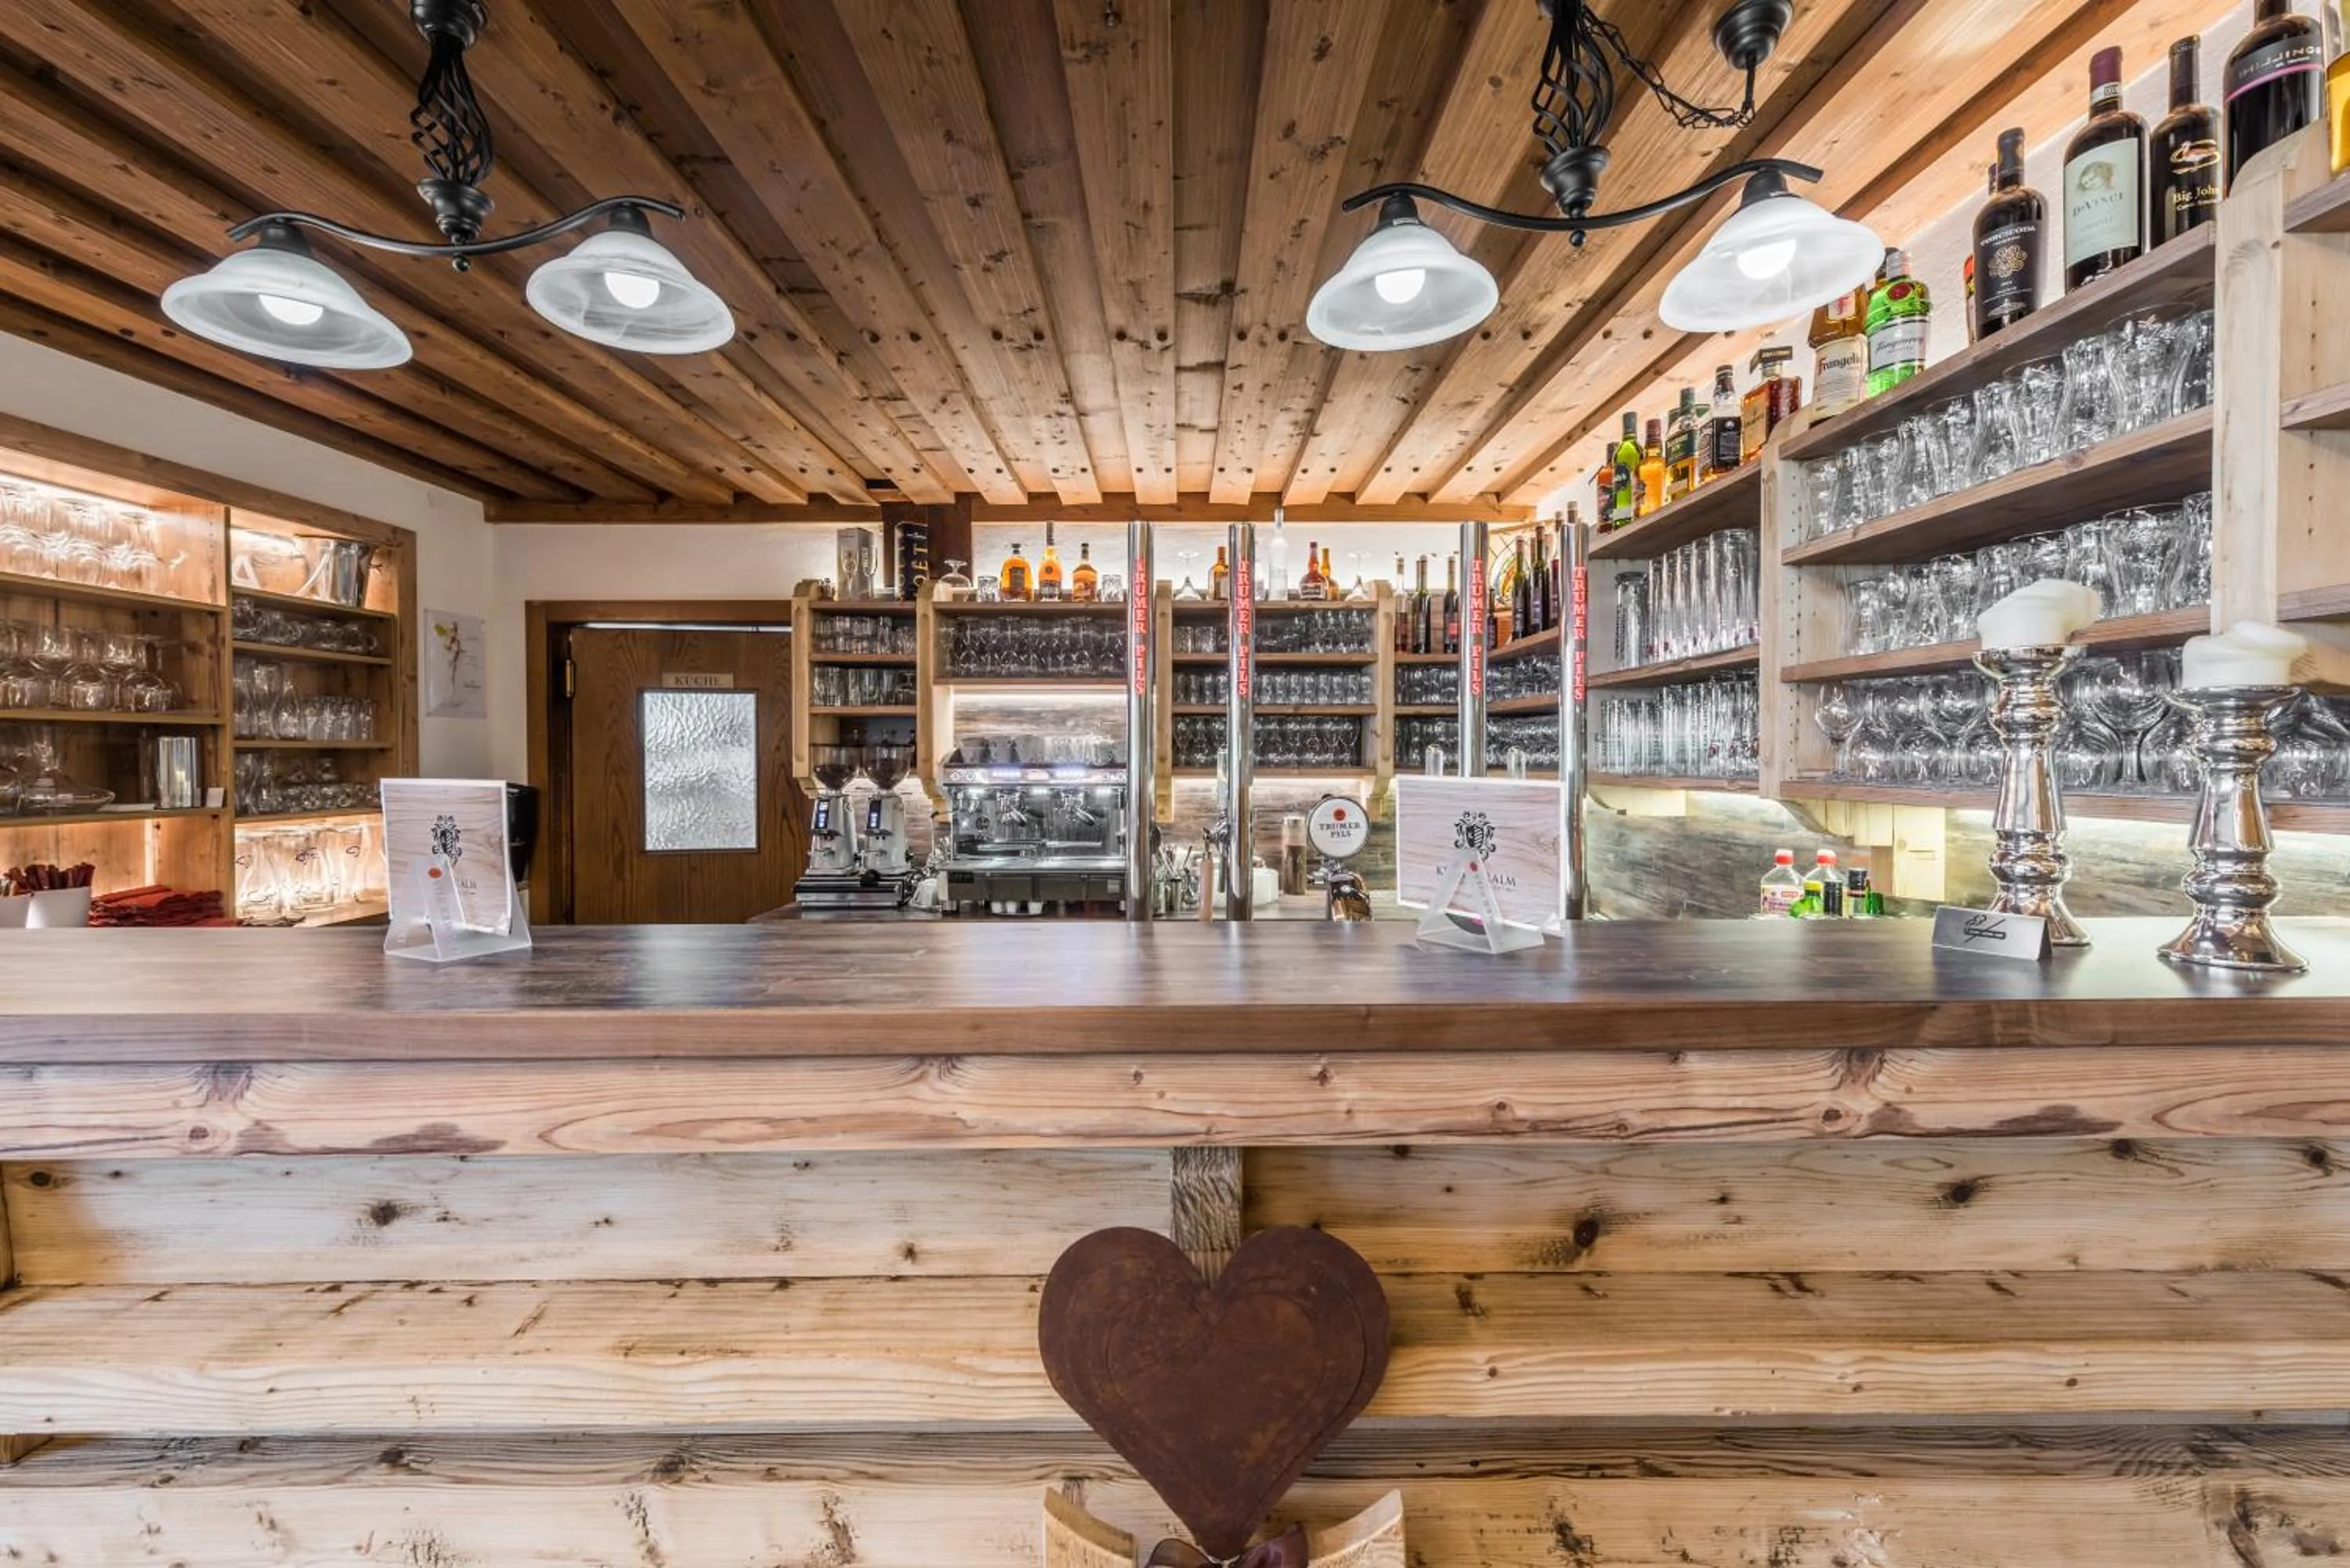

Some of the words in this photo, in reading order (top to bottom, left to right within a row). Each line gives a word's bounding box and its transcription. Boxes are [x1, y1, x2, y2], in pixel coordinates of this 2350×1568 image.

[2173, 191, 2193, 204] Big
[2196, 186, 2219, 198] John
[1238, 559, 1250, 634] TRUMER
[1470, 558, 1483, 634] TRUMER
[1573, 566, 1585, 640] TRUMER
[1135, 645, 1146, 695] PILS
[1238, 645, 1249, 696] PILS
[1471, 645, 1482, 695] PILS
[1574, 651, 1585, 701] PILS
[1331, 830, 1351, 839] PILS
